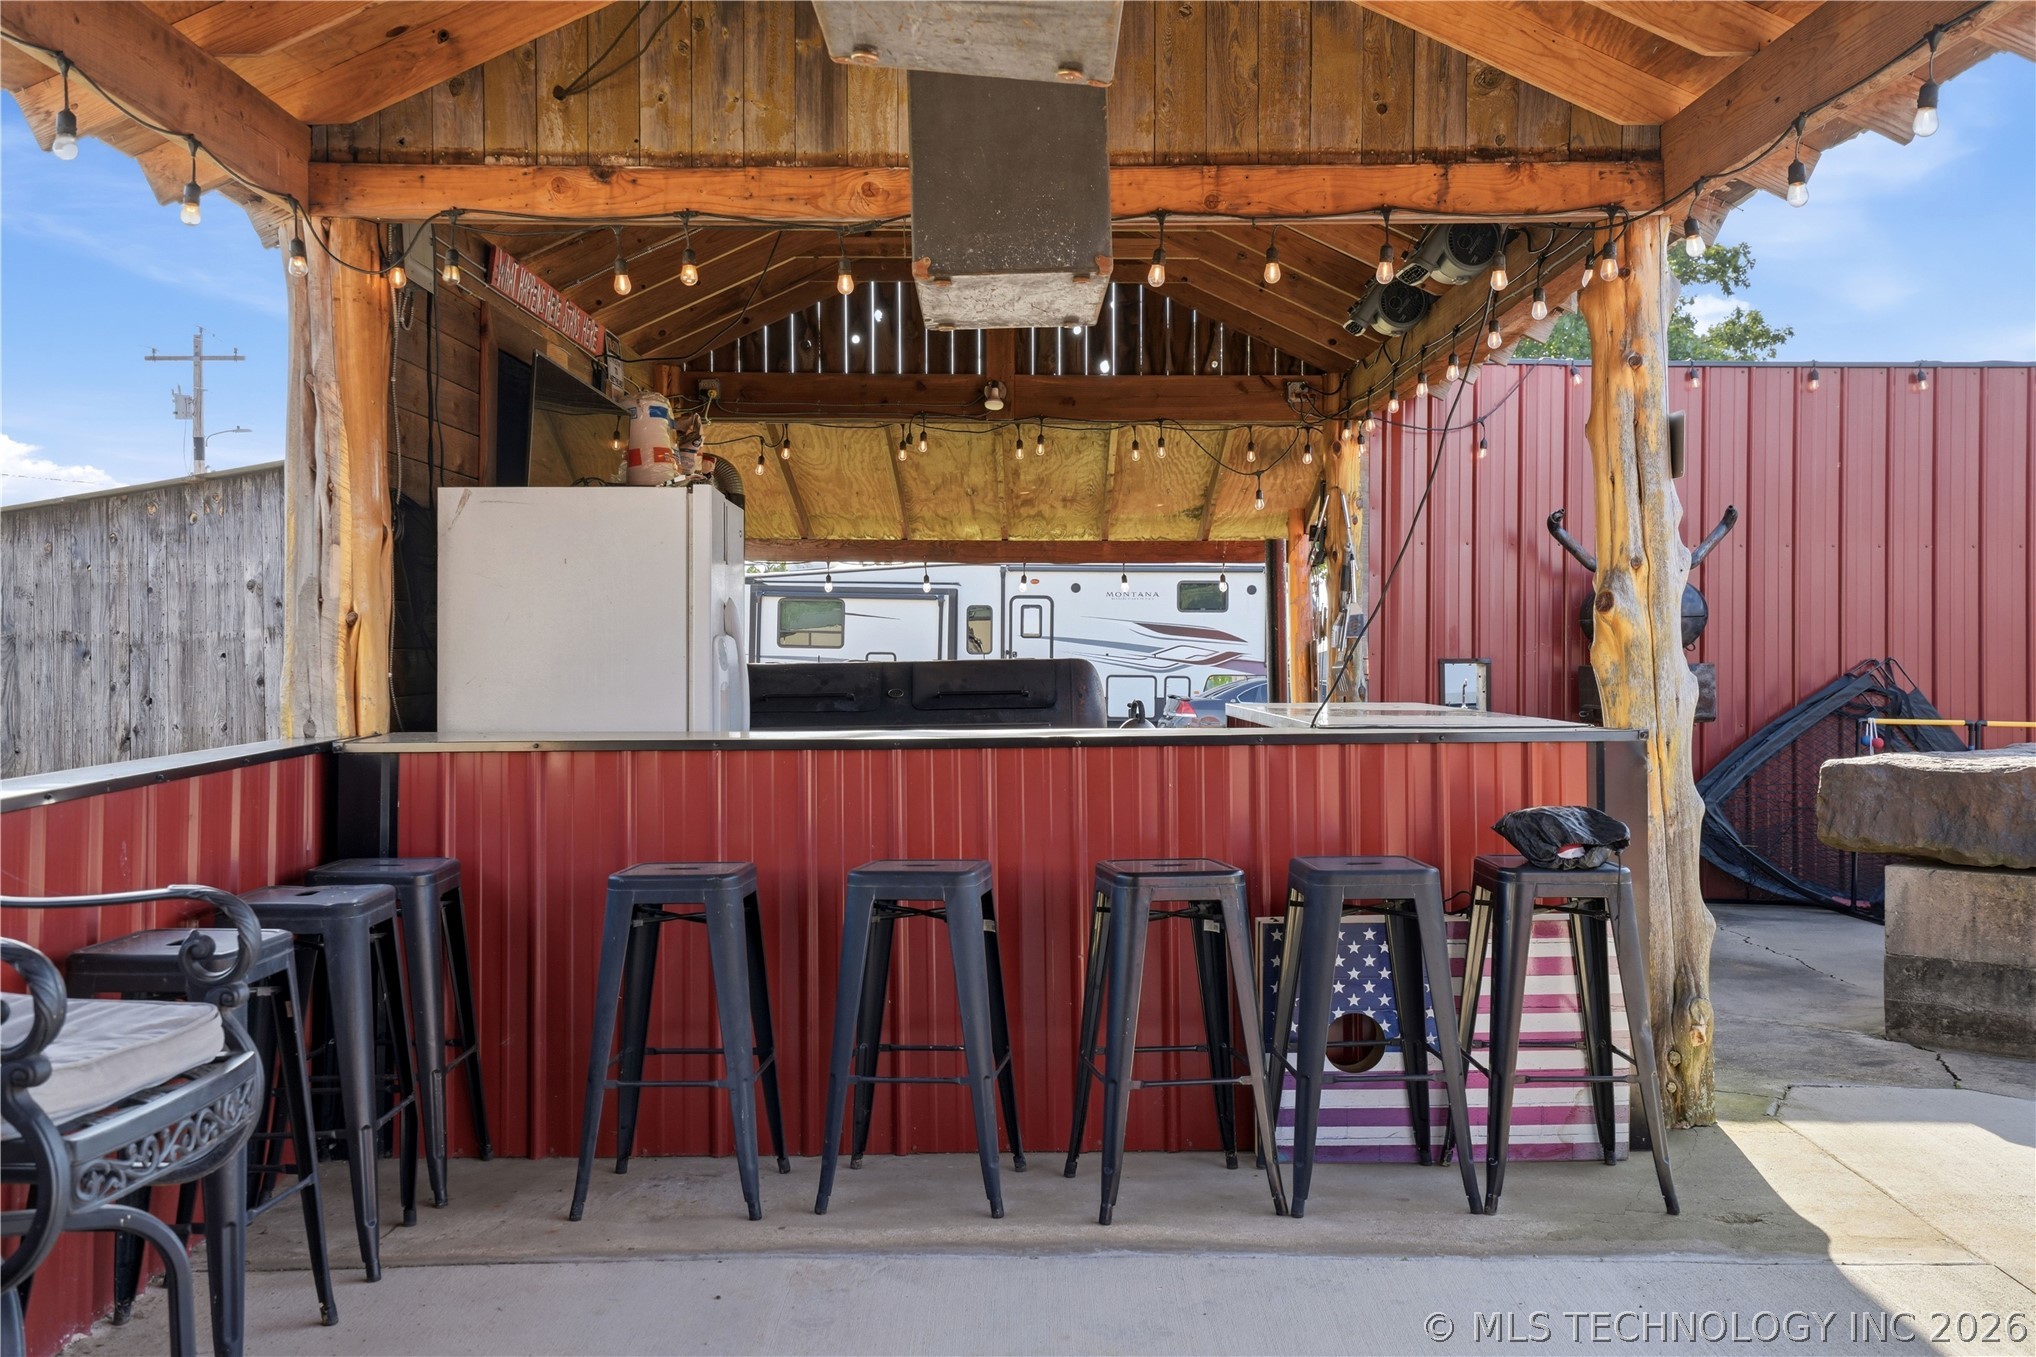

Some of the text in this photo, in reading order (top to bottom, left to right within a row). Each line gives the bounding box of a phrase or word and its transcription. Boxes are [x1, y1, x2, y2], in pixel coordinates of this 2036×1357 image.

[496, 249, 519, 298] WHAT
[517, 267, 546, 314] HAPPENS
[545, 288, 562, 327] HERE
[562, 301, 581, 339] STAYS
[581, 314, 599, 352] HERE
